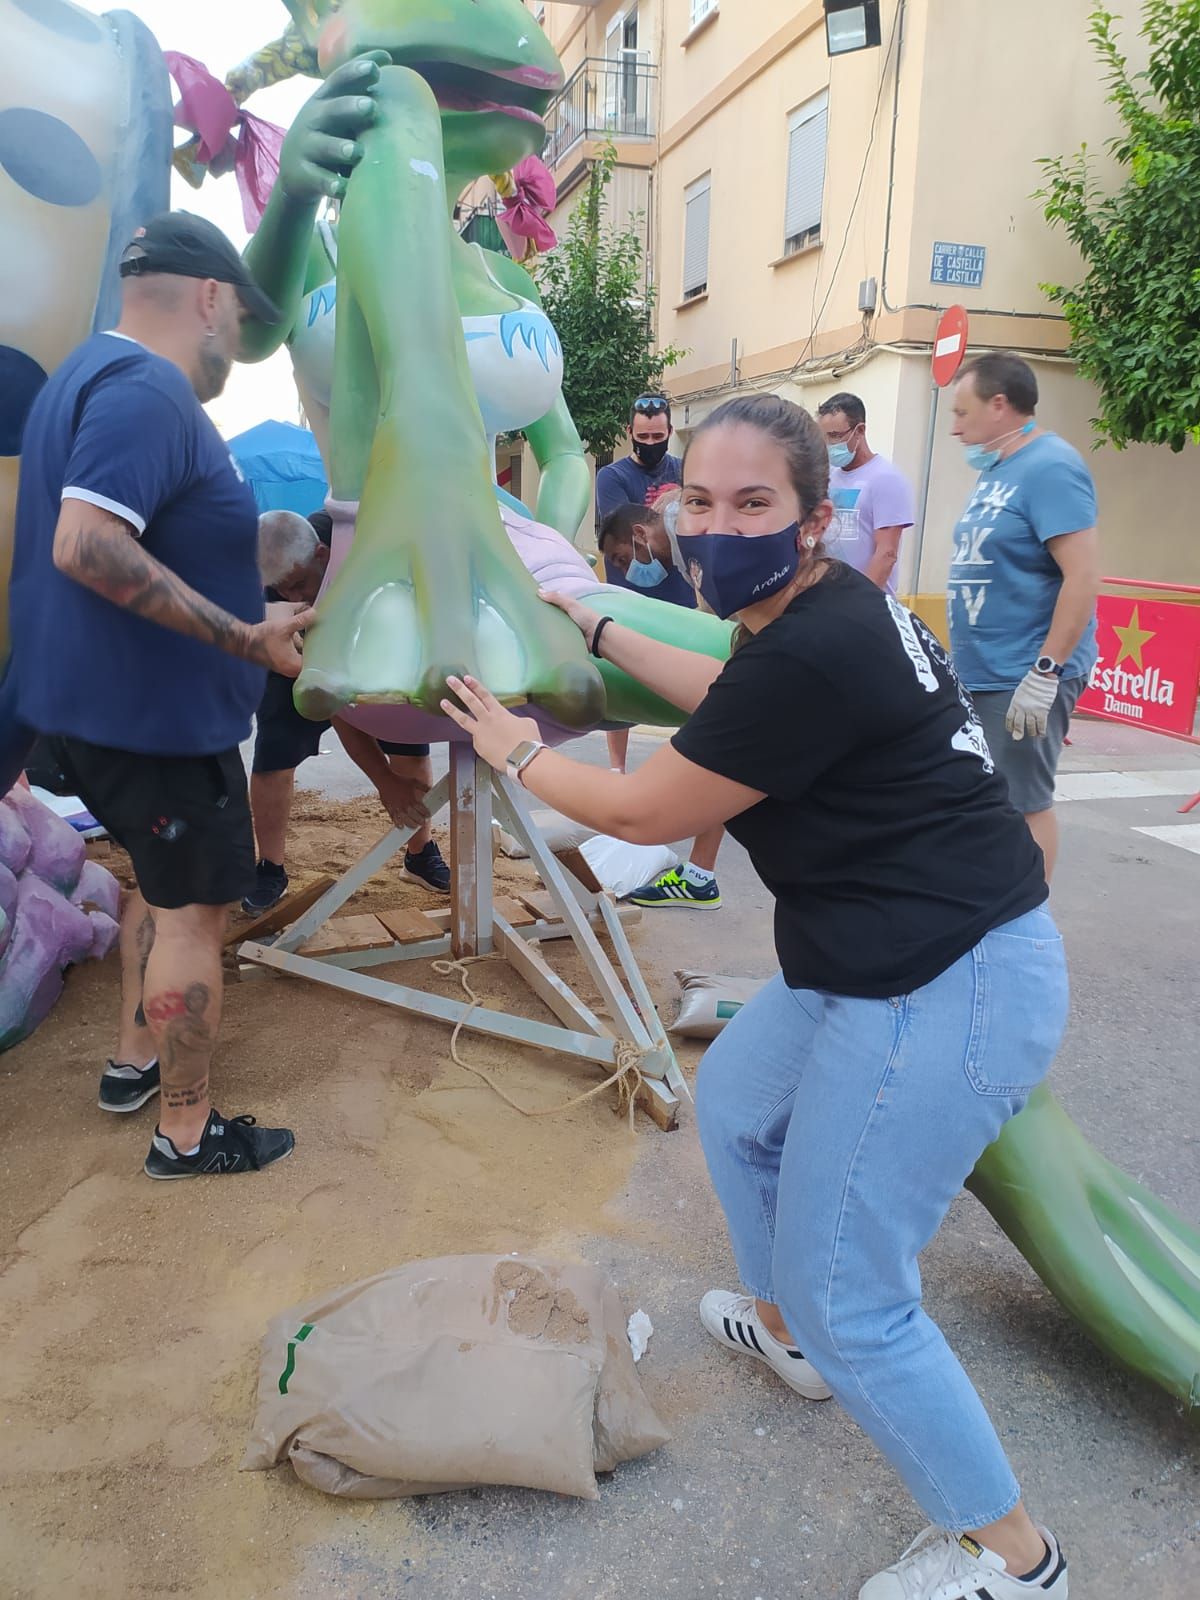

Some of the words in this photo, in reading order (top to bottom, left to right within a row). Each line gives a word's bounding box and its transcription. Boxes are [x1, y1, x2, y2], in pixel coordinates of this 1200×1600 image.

[935, 244, 957, 255] CARRER
[965, 248, 984, 258] CALLE
[934, 255, 944, 267] DE
[947, 257, 982, 271] CASTELLA
[933, 268, 943, 280] DE
[946, 269, 980, 284] CASTILLA
[752, 564, 790, 595] Aroha
[1088, 657, 1175, 706] Estrella
[1104, 693, 1144, 719] Damm
[688, 868, 708, 881] FILA
